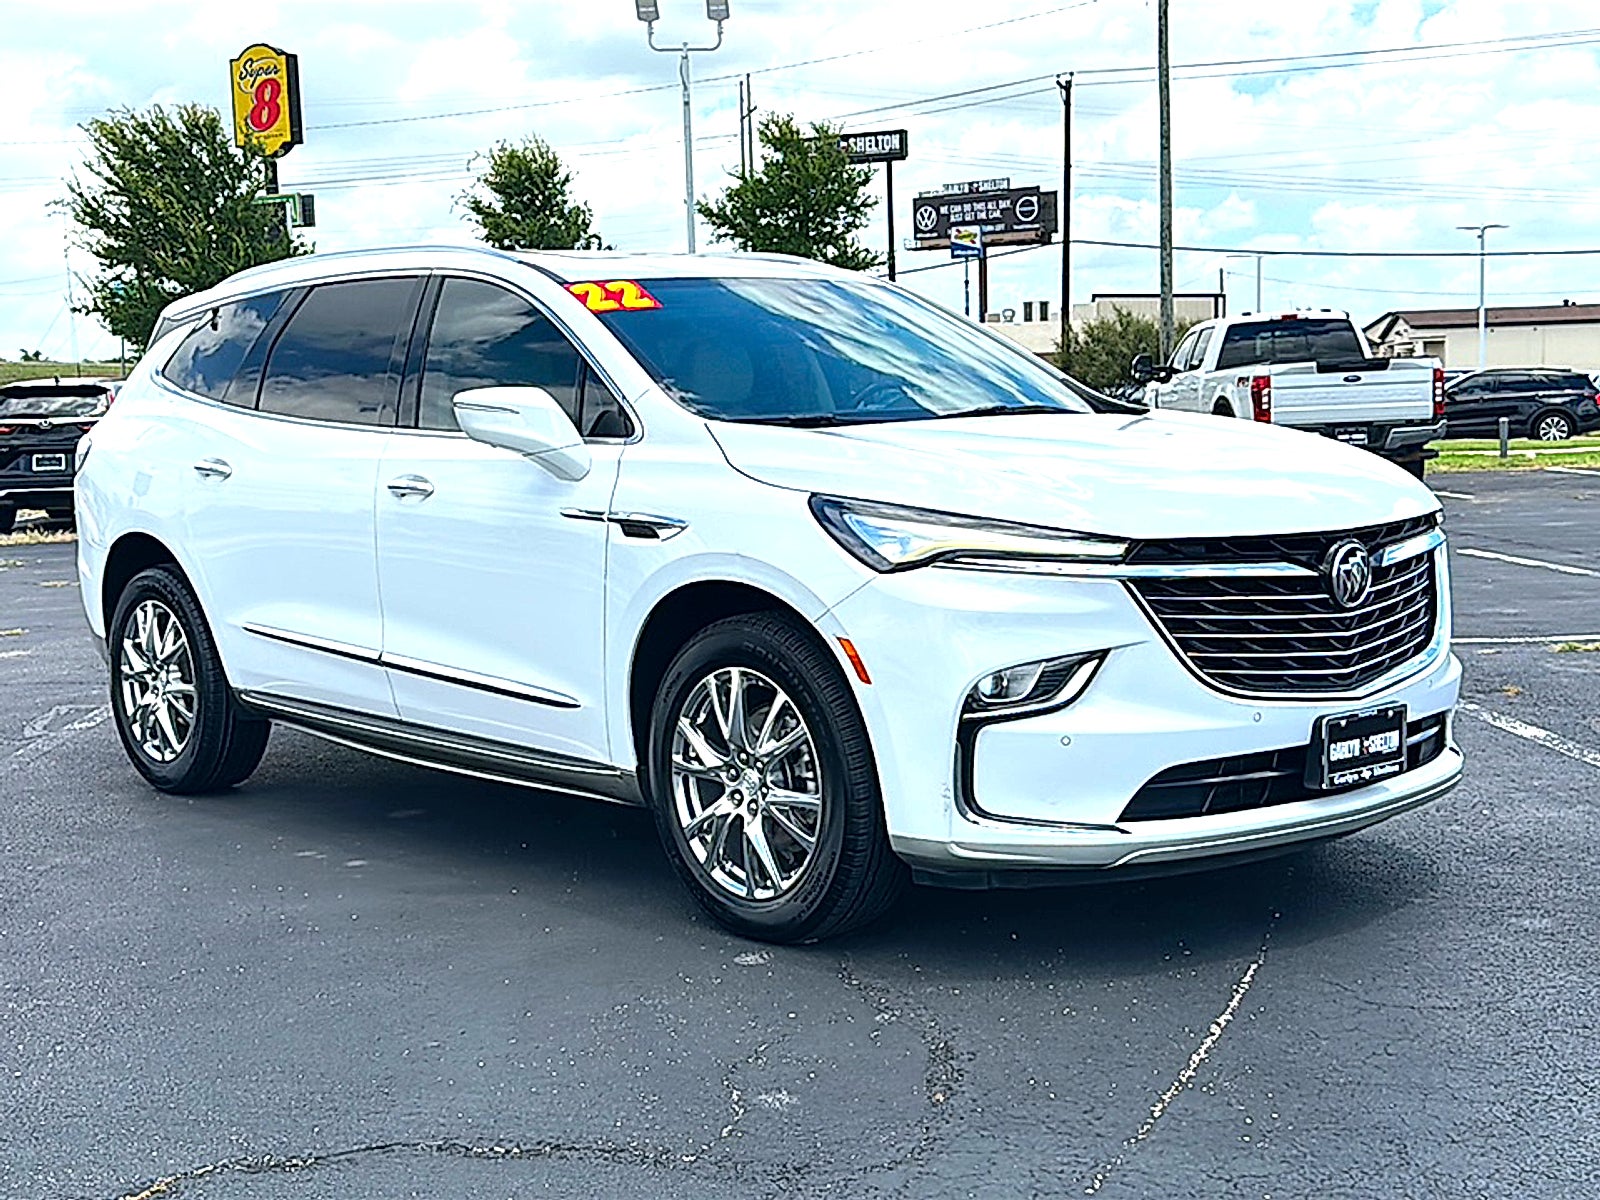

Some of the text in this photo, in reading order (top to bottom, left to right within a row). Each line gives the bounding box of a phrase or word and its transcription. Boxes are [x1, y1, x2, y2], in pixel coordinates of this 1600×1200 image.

[239, 58, 281, 89] Super
[250, 78, 281, 132] 8
[848, 134, 900, 152] SHELTON
[569, 281, 655, 311] 22
